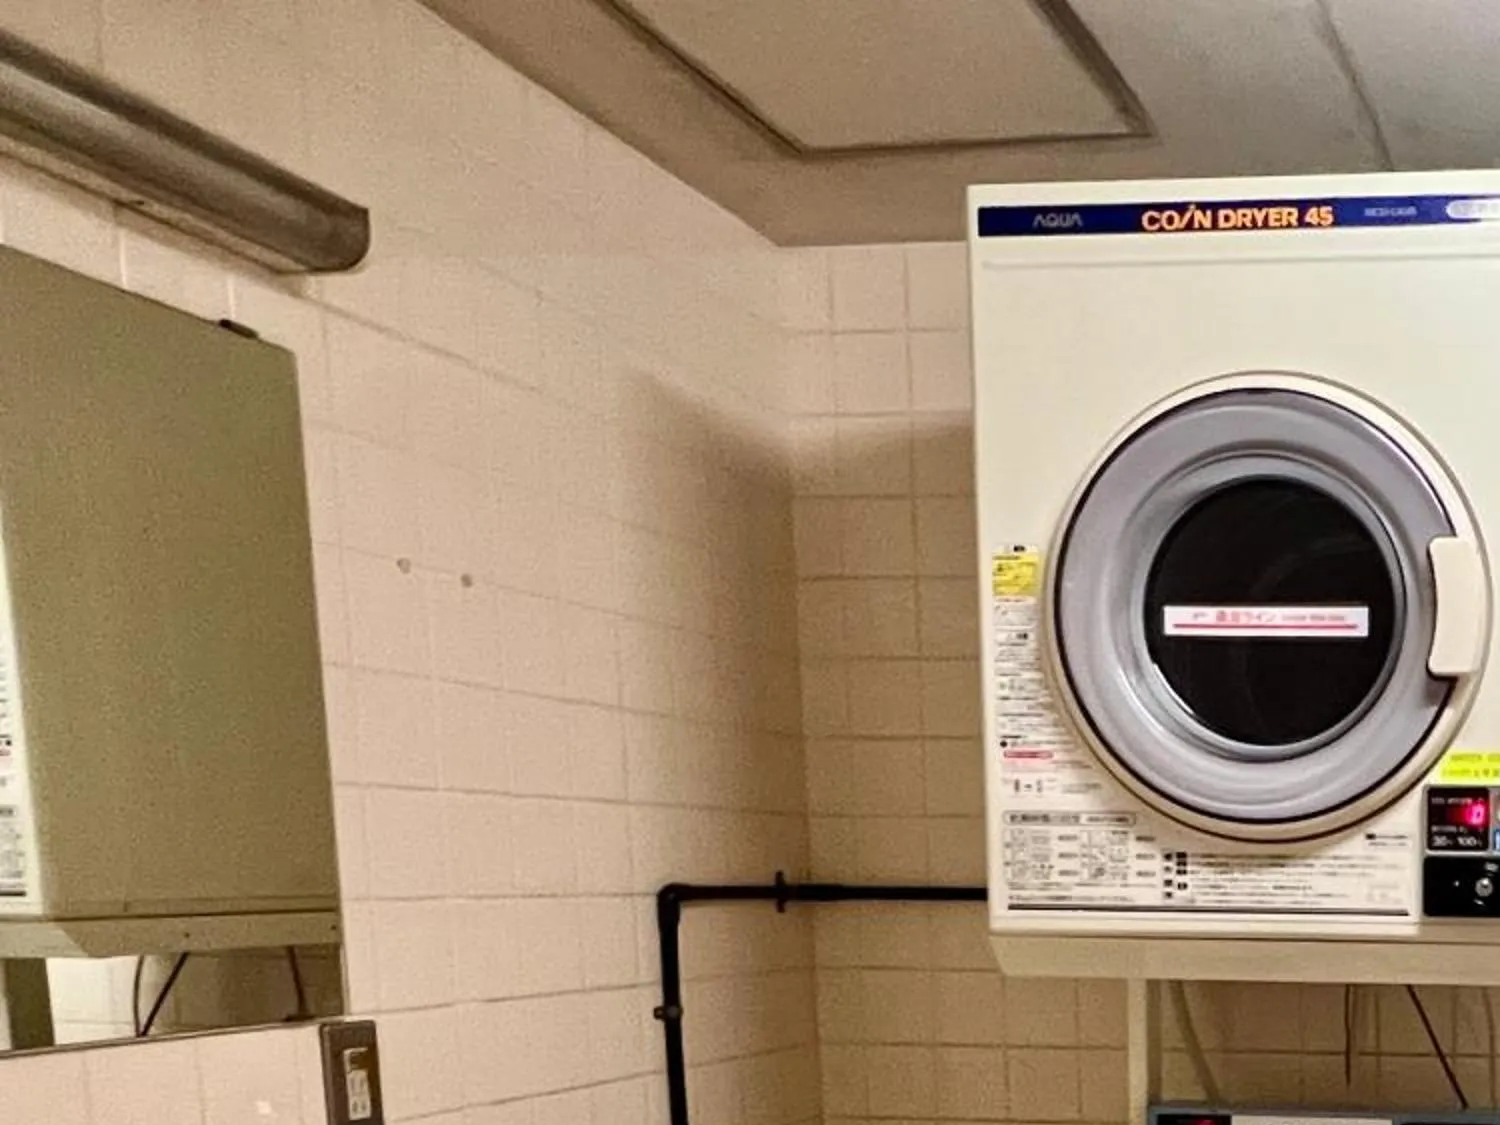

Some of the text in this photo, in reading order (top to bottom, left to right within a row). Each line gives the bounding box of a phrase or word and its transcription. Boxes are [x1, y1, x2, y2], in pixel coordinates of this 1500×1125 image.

[1032, 211, 1084, 228] AQUA
[1218, 206, 1299, 229] DRYER
[1304, 205, 1334, 226] 45
